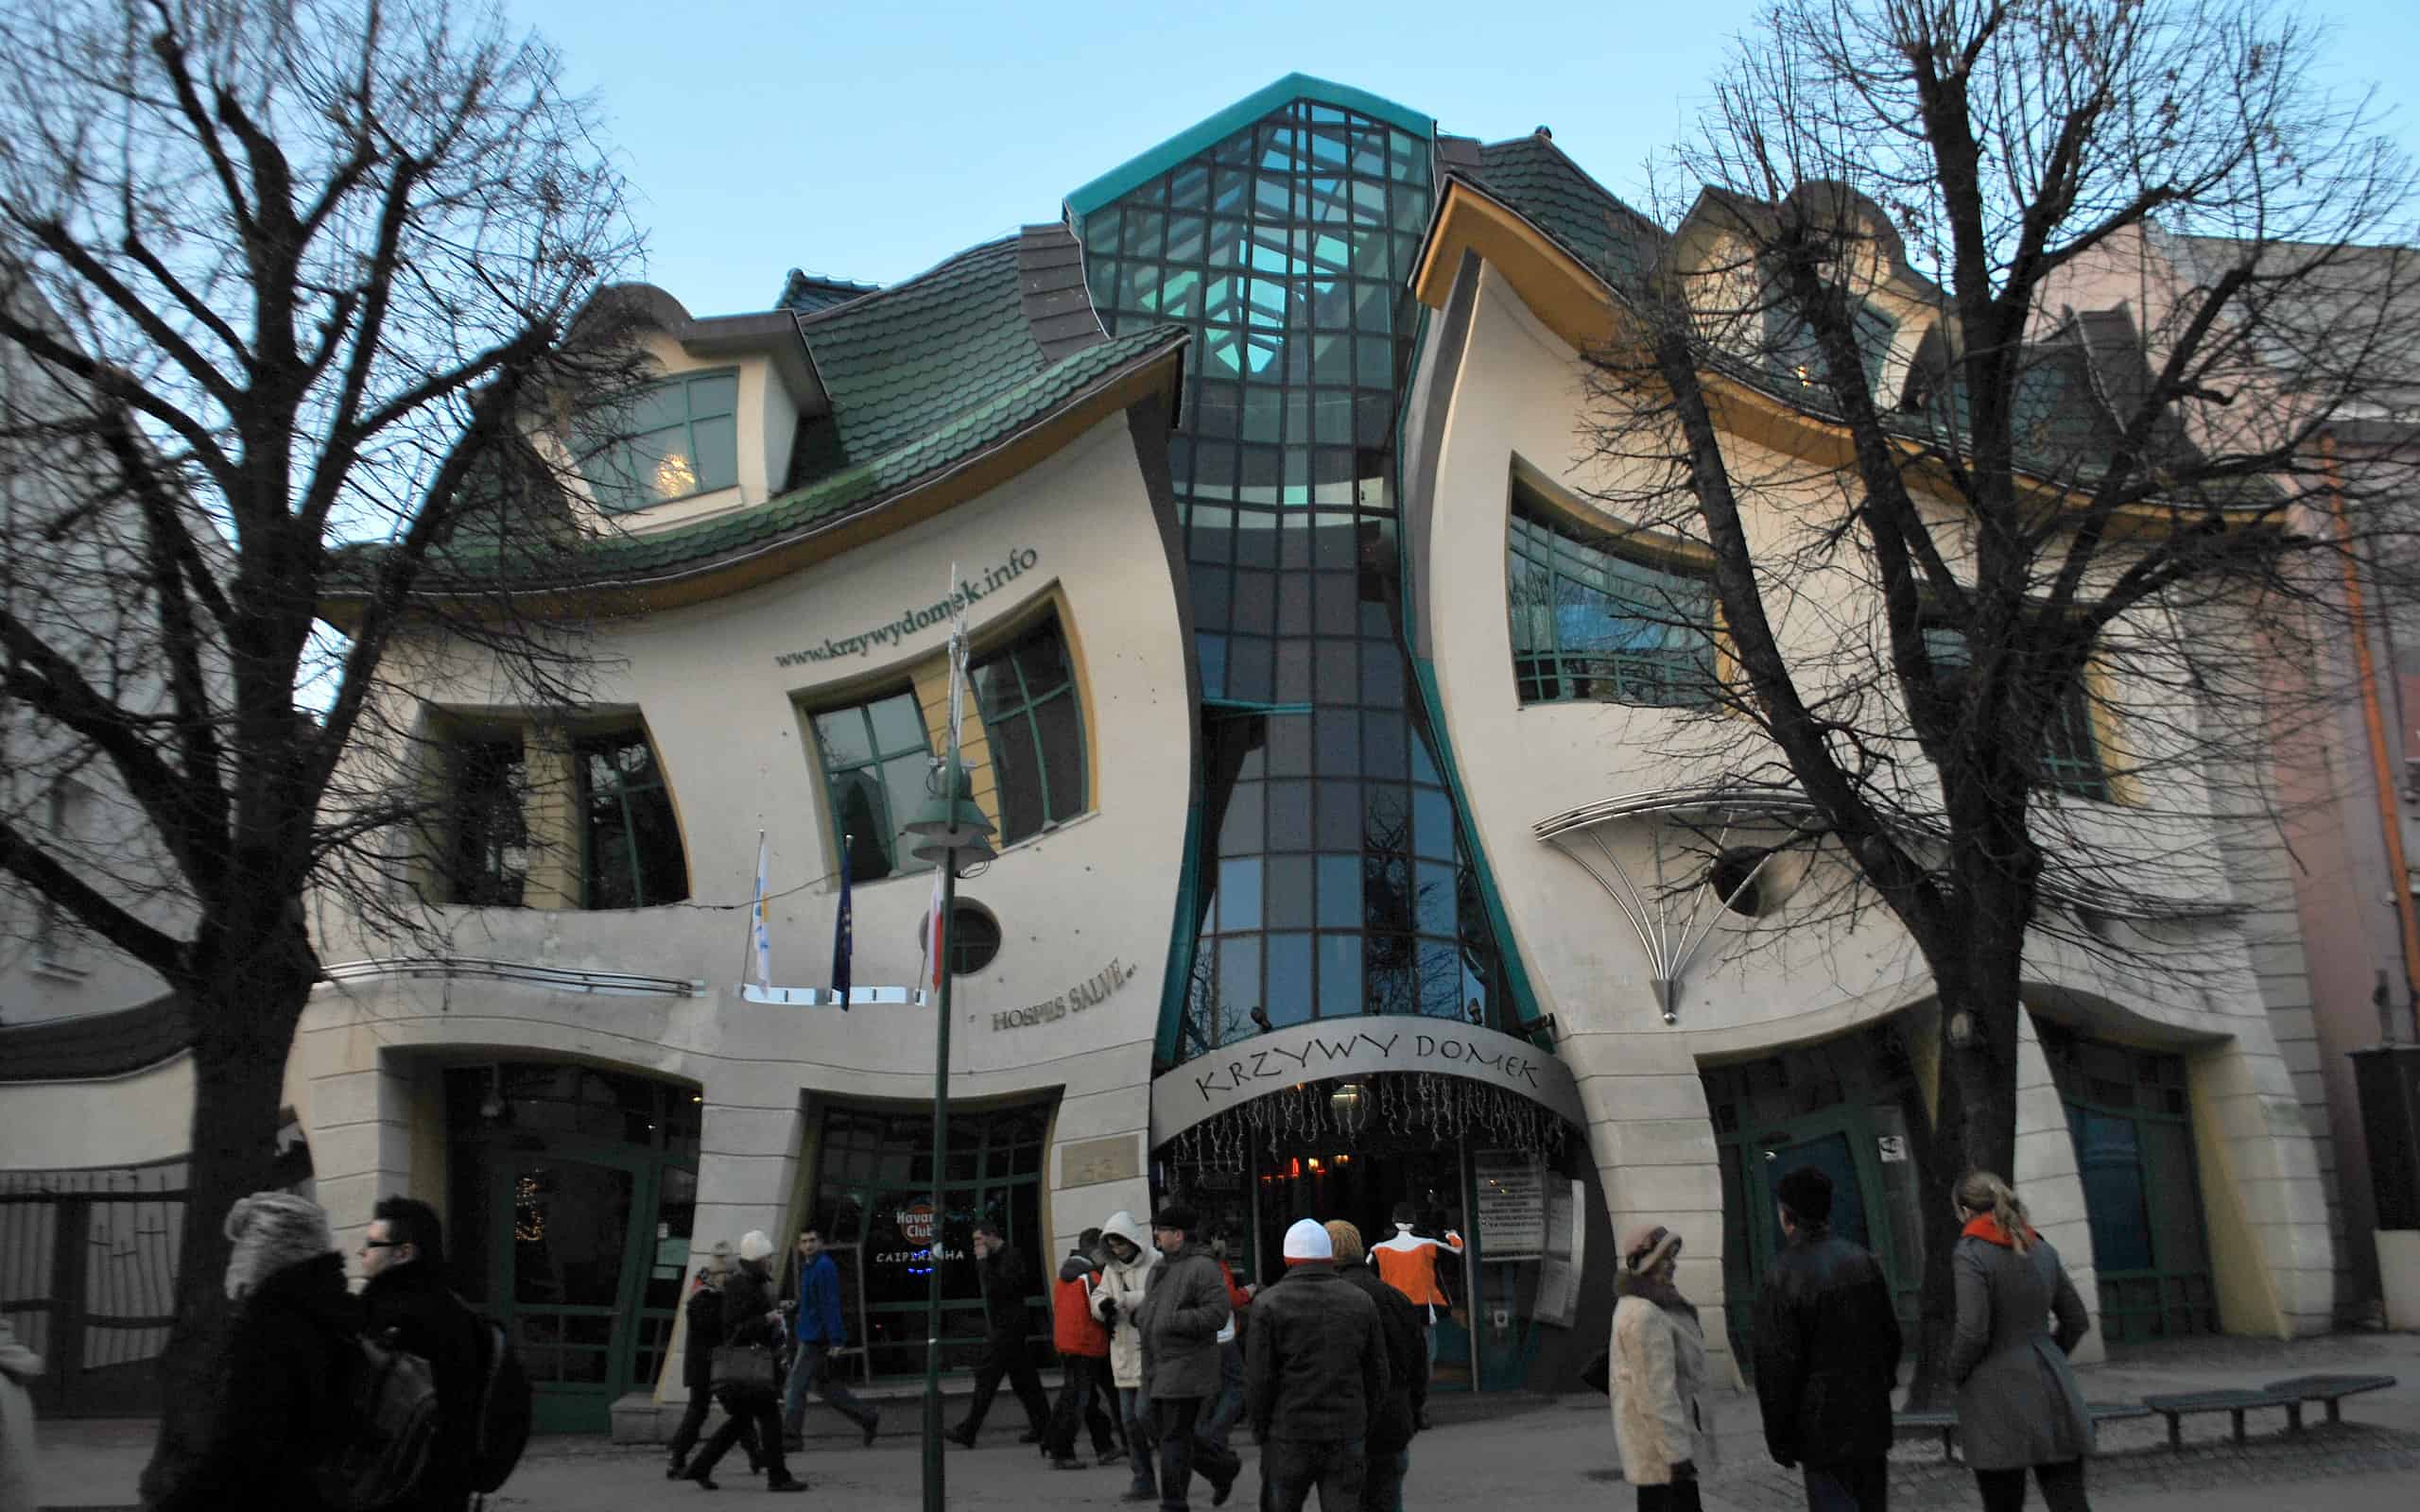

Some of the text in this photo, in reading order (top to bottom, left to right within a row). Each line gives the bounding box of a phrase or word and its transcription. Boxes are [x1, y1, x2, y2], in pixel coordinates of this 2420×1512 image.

[774, 547, 1038, 667] www.krzywydomek.info
[993, 957, 1125, 1032] HOSPES SALVE
[1196, 1033, 1539, 1102] KRZYWY DOMEK
